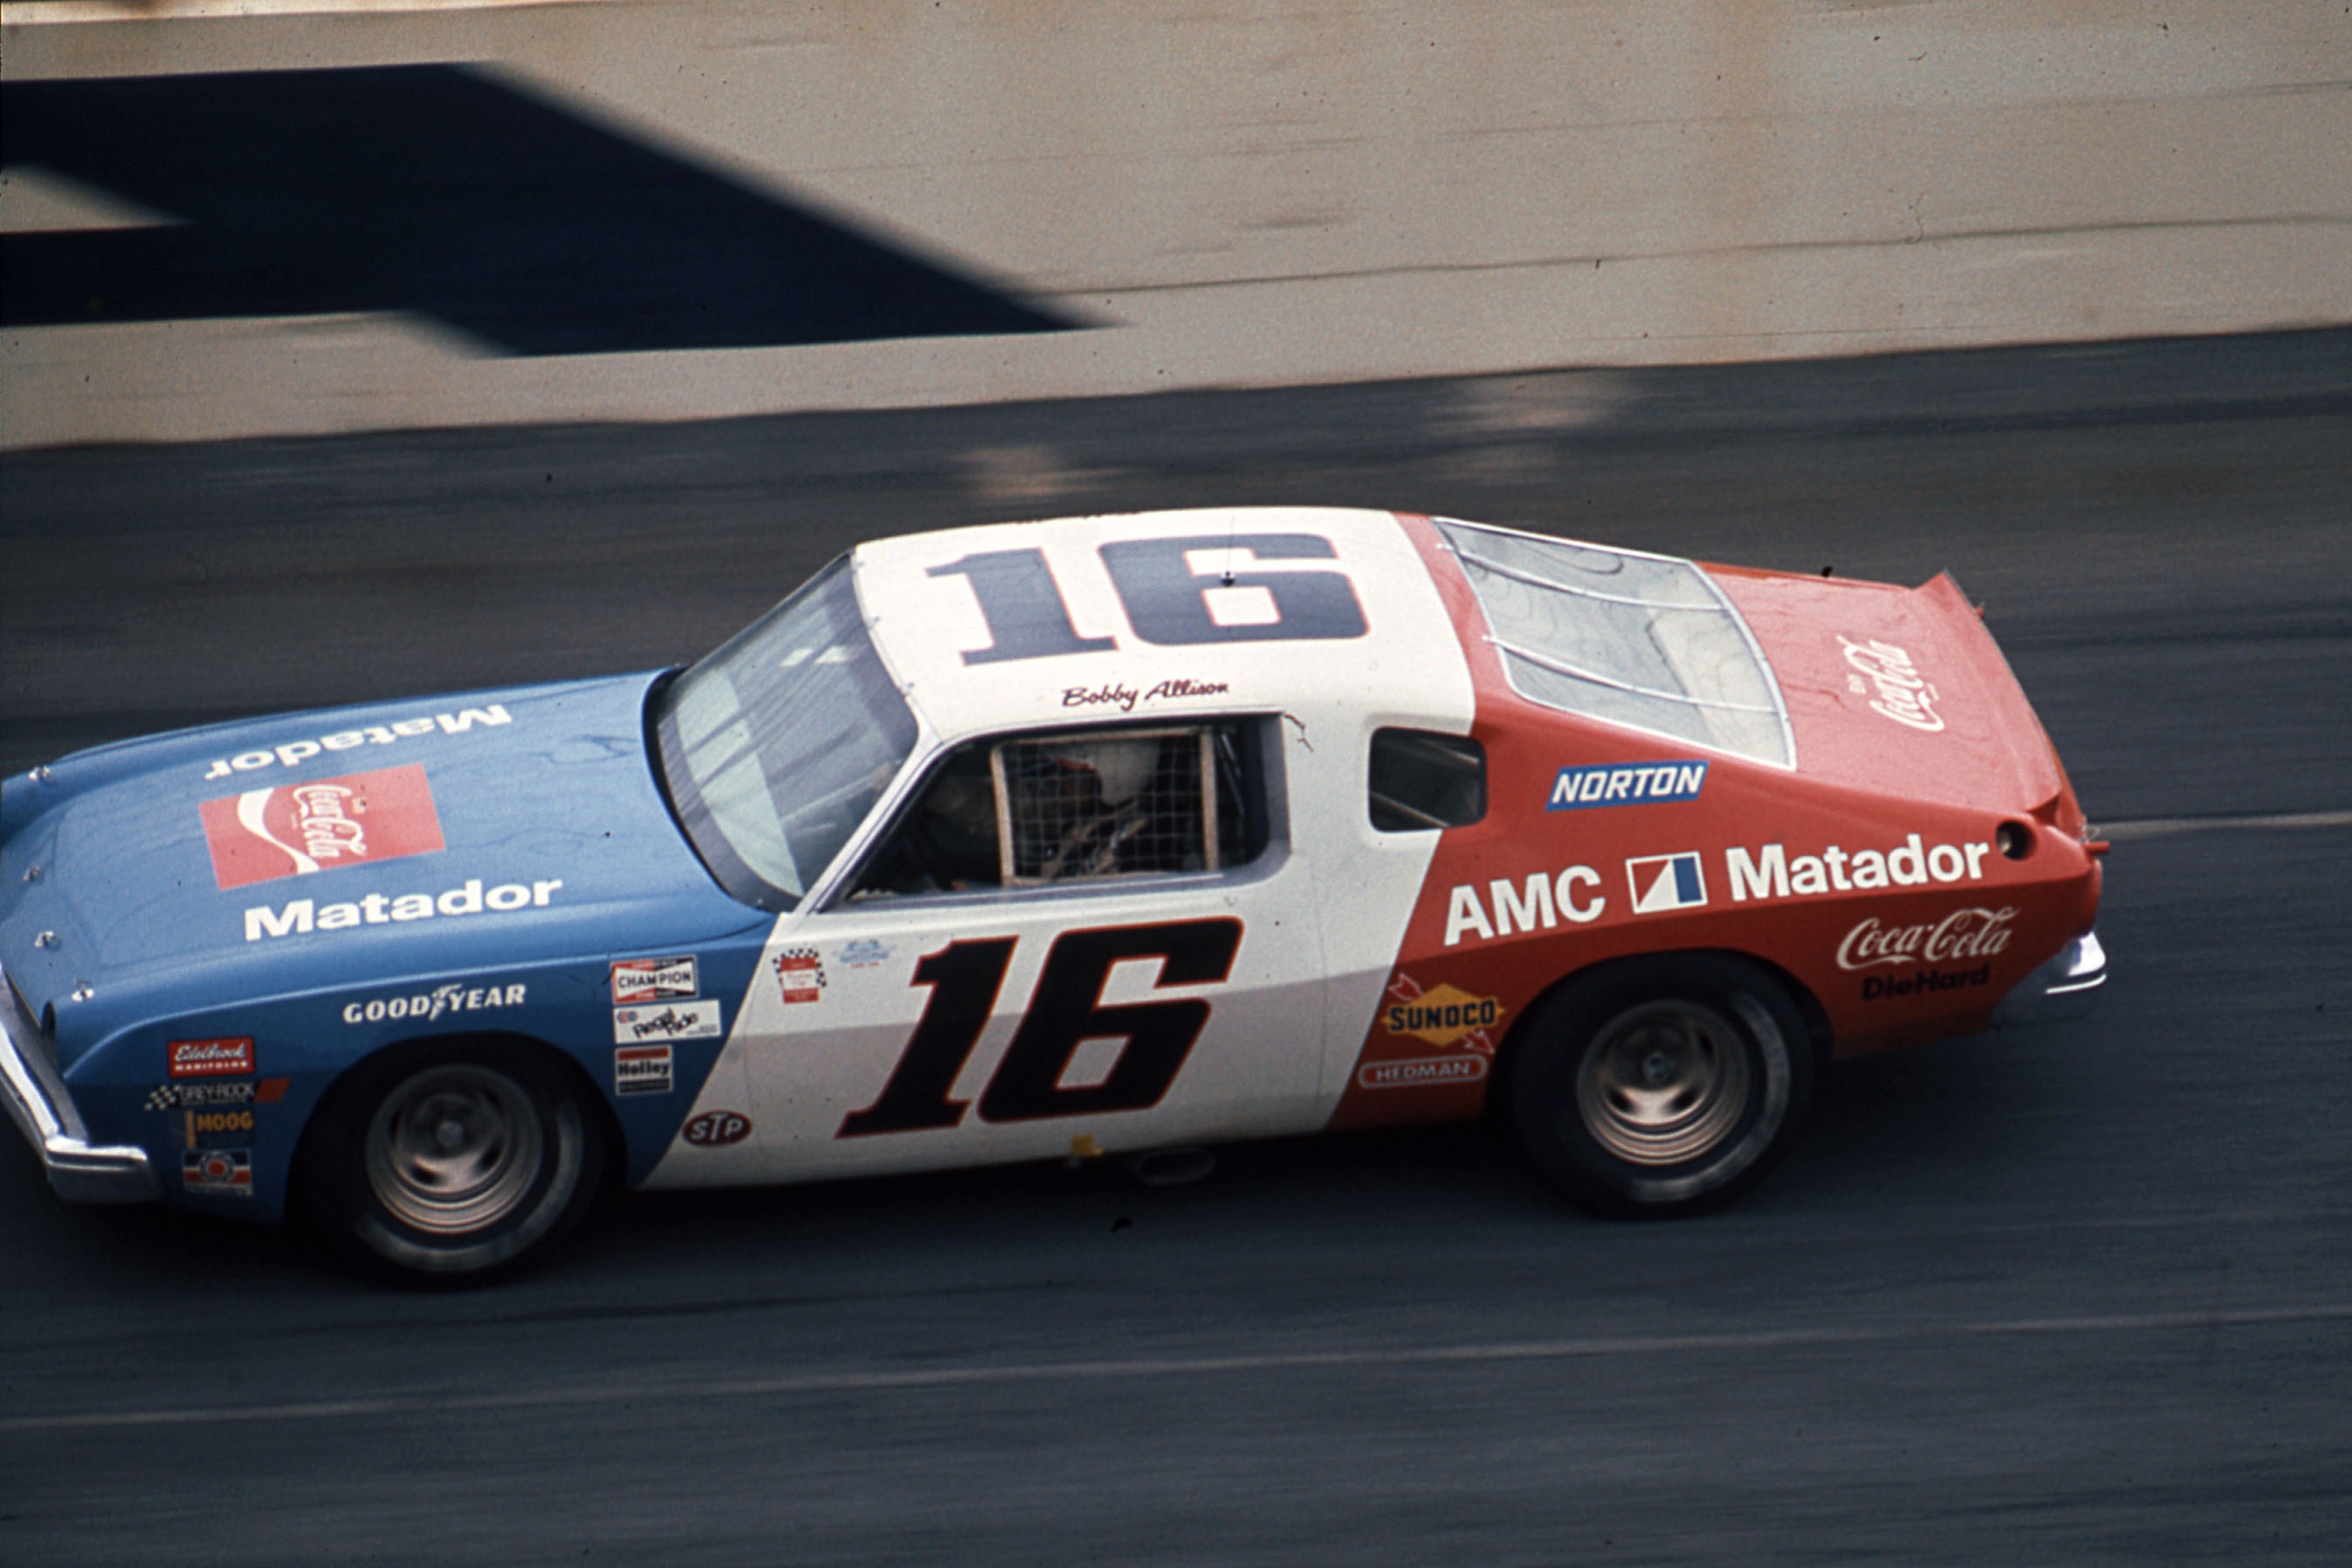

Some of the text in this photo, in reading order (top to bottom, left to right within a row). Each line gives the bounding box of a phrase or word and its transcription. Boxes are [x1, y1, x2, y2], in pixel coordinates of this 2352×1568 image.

[924, 533, 1370, 666] 16
[1062, 679, 1228, 712] Bobby Allison
[205, 704, 512, 781] Matador
[1552, 766, 1705, 804] NORTON
[1443, 834, 1990, 947] AMC Matador
[245, 878, 563, 942] Matador
[1836, 906, 2021, 971] Coca-Cola
[618, 971, 692, 989] CHAMPION
[1862, 963, 1990, 1000] DieHard
[342, 983, 526, 1024] GOODYEAR
[1390, 1000, 1496, 1031] SUNOCO
[835, 916, 1245, 1139] 16
[618, 1059, 671, 1077] Holley
[1376, 1062, 1471, 1082] HEDMAN
[197, 1112, 253, 1132] MOOG
[689, 1113, 744, 1142] STP
